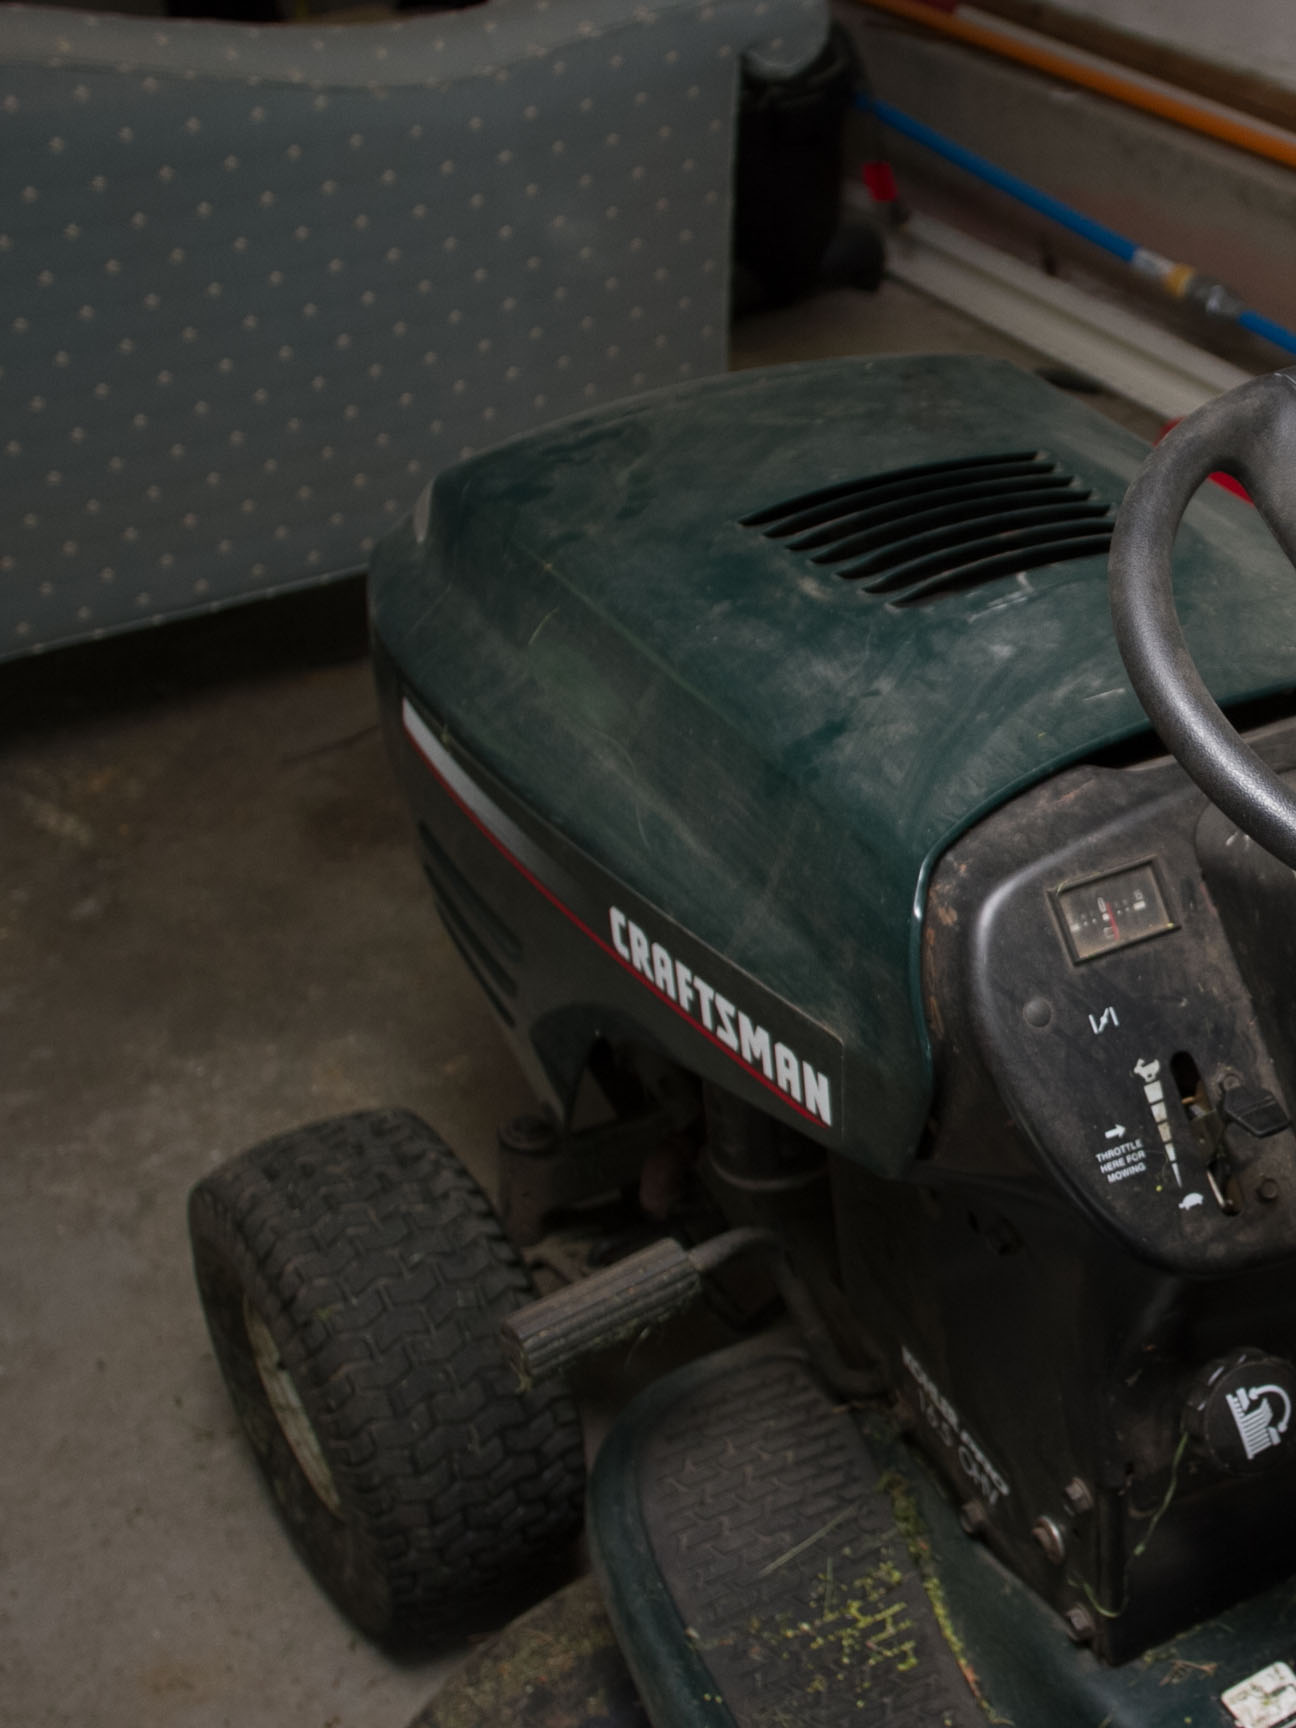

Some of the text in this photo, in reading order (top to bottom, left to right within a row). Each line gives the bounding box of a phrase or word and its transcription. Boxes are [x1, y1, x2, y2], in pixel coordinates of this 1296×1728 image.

[608, 905, 833, 1127] CRAFTSMAN
[1095, 1139, 1144, 1162] THROTTLE
[1100, 1150, 1146, 1174] HERE FOR
[1107, 1162, 1147, 1183] MOWING
